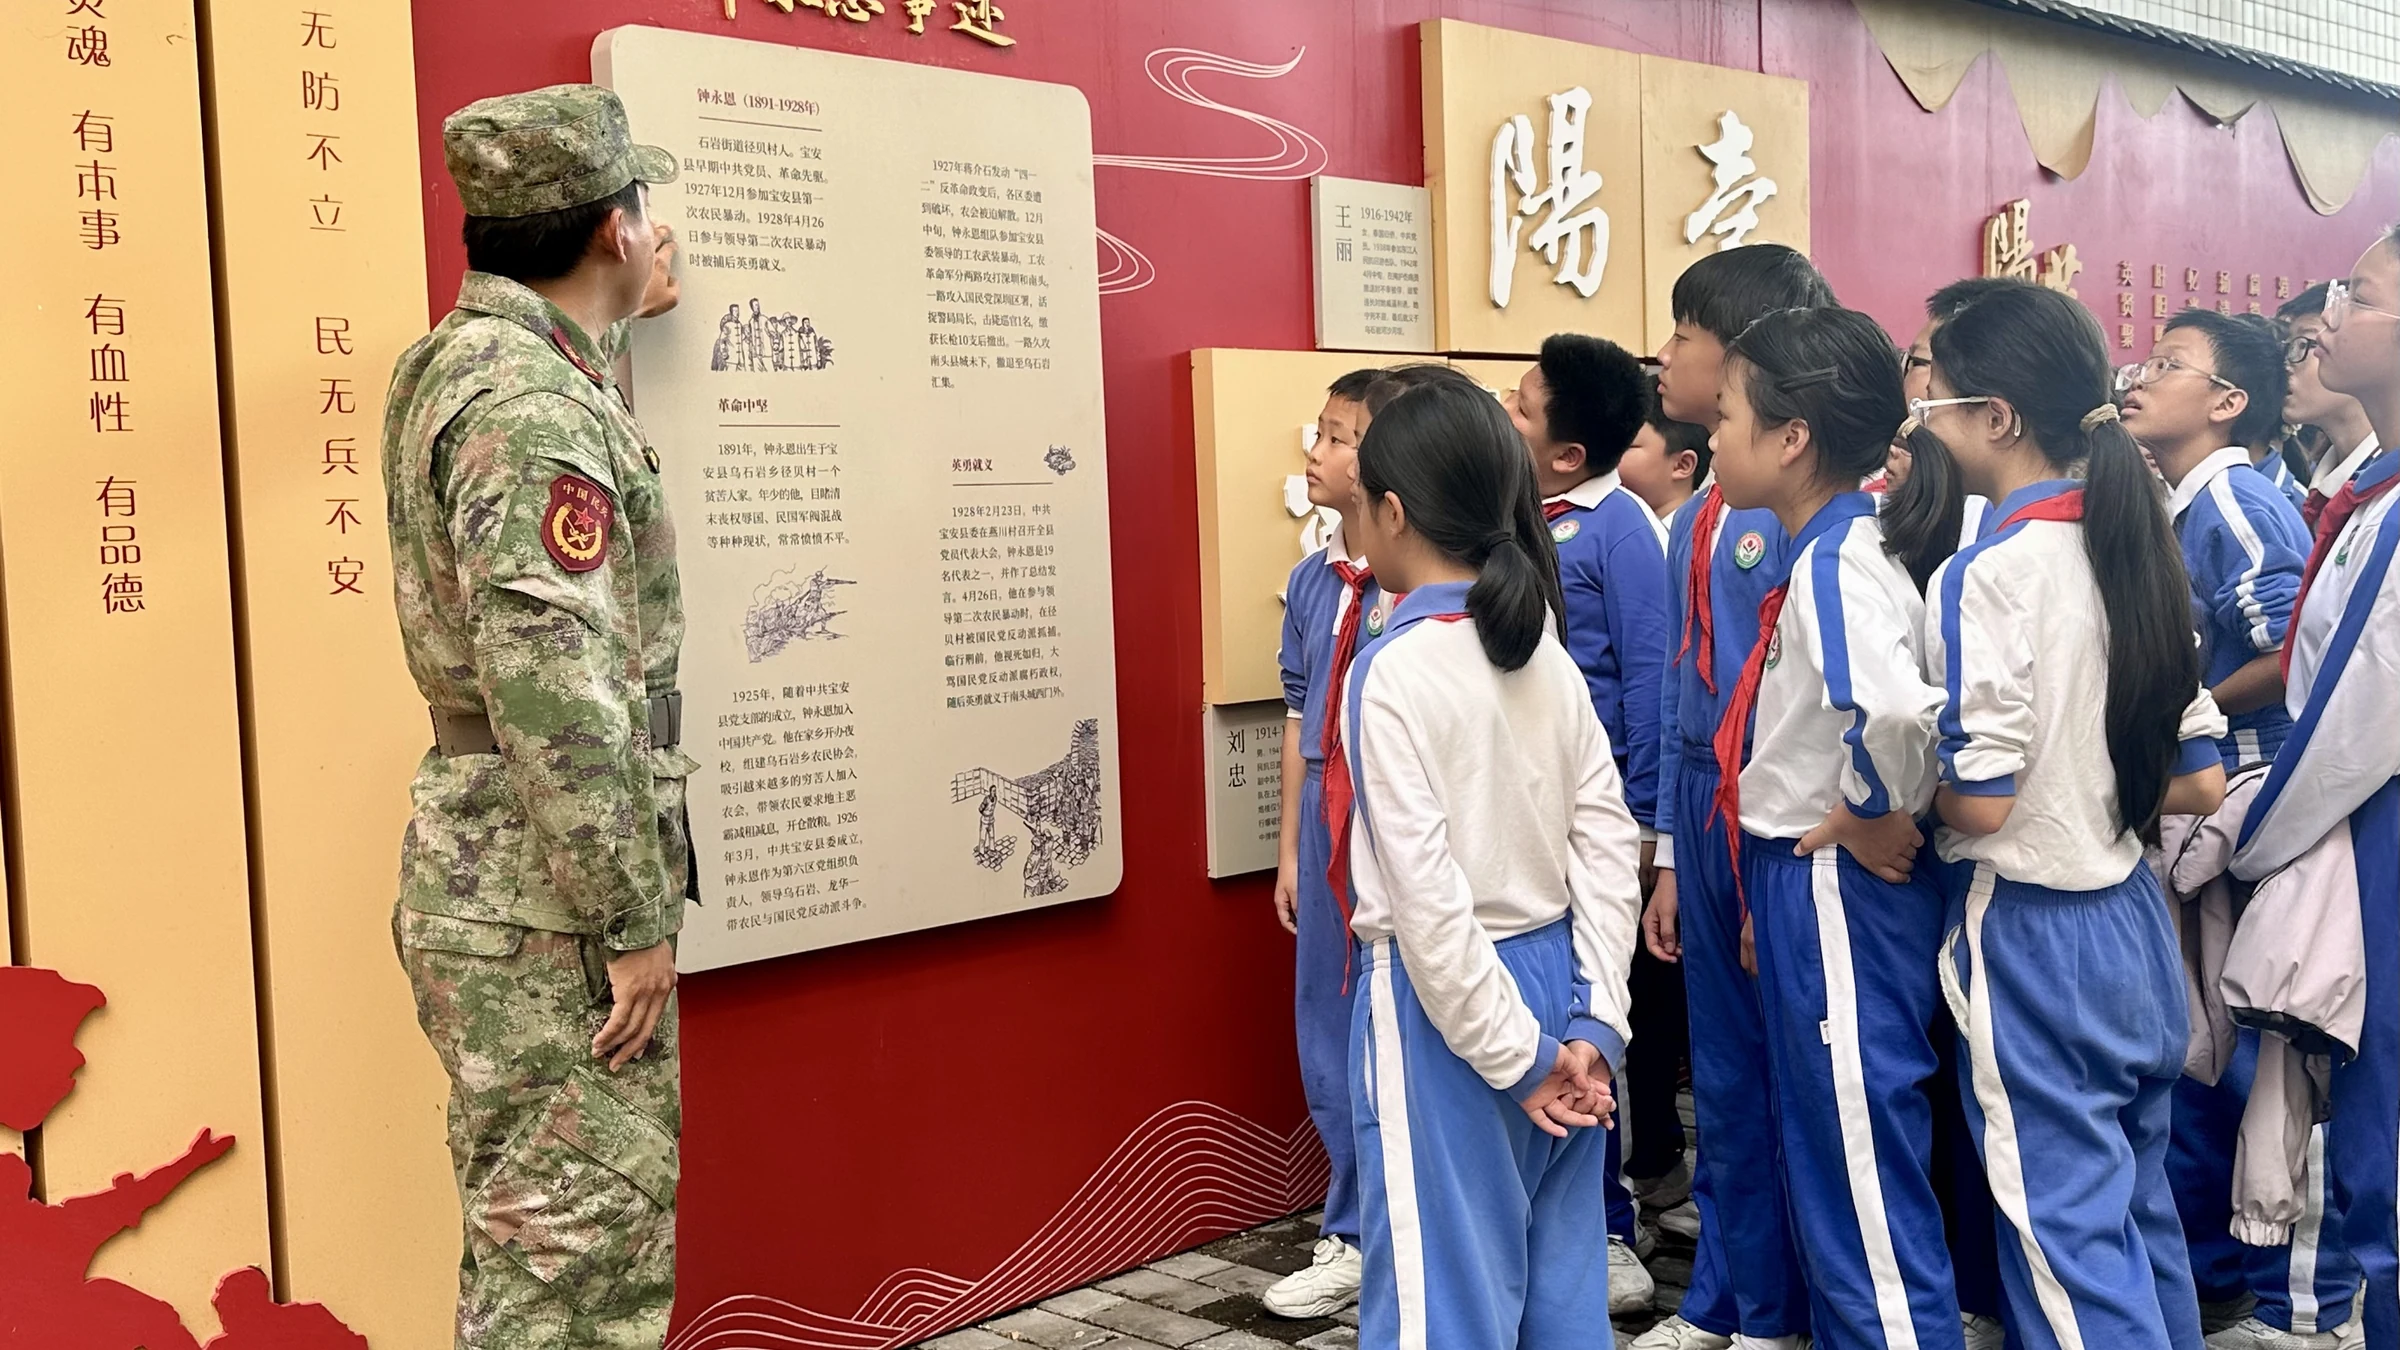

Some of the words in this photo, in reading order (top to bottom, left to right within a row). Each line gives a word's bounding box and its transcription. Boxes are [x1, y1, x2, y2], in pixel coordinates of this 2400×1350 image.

[302, 11, 346, 232] 无防不立
[72, 109, 121, 250] 有本事
[685, 183, 824, 205] 1927年12月参加宝安县第一
[686, 206, 824, 228] 次农民暴动。1928年4月26
[1361, 207, 1413, 224] 1916-1942年
[689, 231, 826, 251] 日参与领导第二次农民暴动
[1335, 205, 1352, 261] 王丽
[689, 254, 786, 272] 时被捕后英勇就义。
[84, 294, 134, 434] 有血性
[931, 376, 955, 389] 汇集。
[719, 399, 768, 412] 革命中坚
[316, 316, 365, 596] 民无兵不安
[952, 459, 993, 472] 英勇就义
[703, 465, 841, 479] 安县乌石岩乡径贝村一个
[563, 483, 608, 518] 中国民兵
[96, 475, 146, 614] 有品德
[1227, 729, 1246, 788] 刘忠
[721, 768, 858, 795] 吸引越来越多的穷苦人加入
[725, 855, 859, 886] 钟永恩作为第六区党组织负
